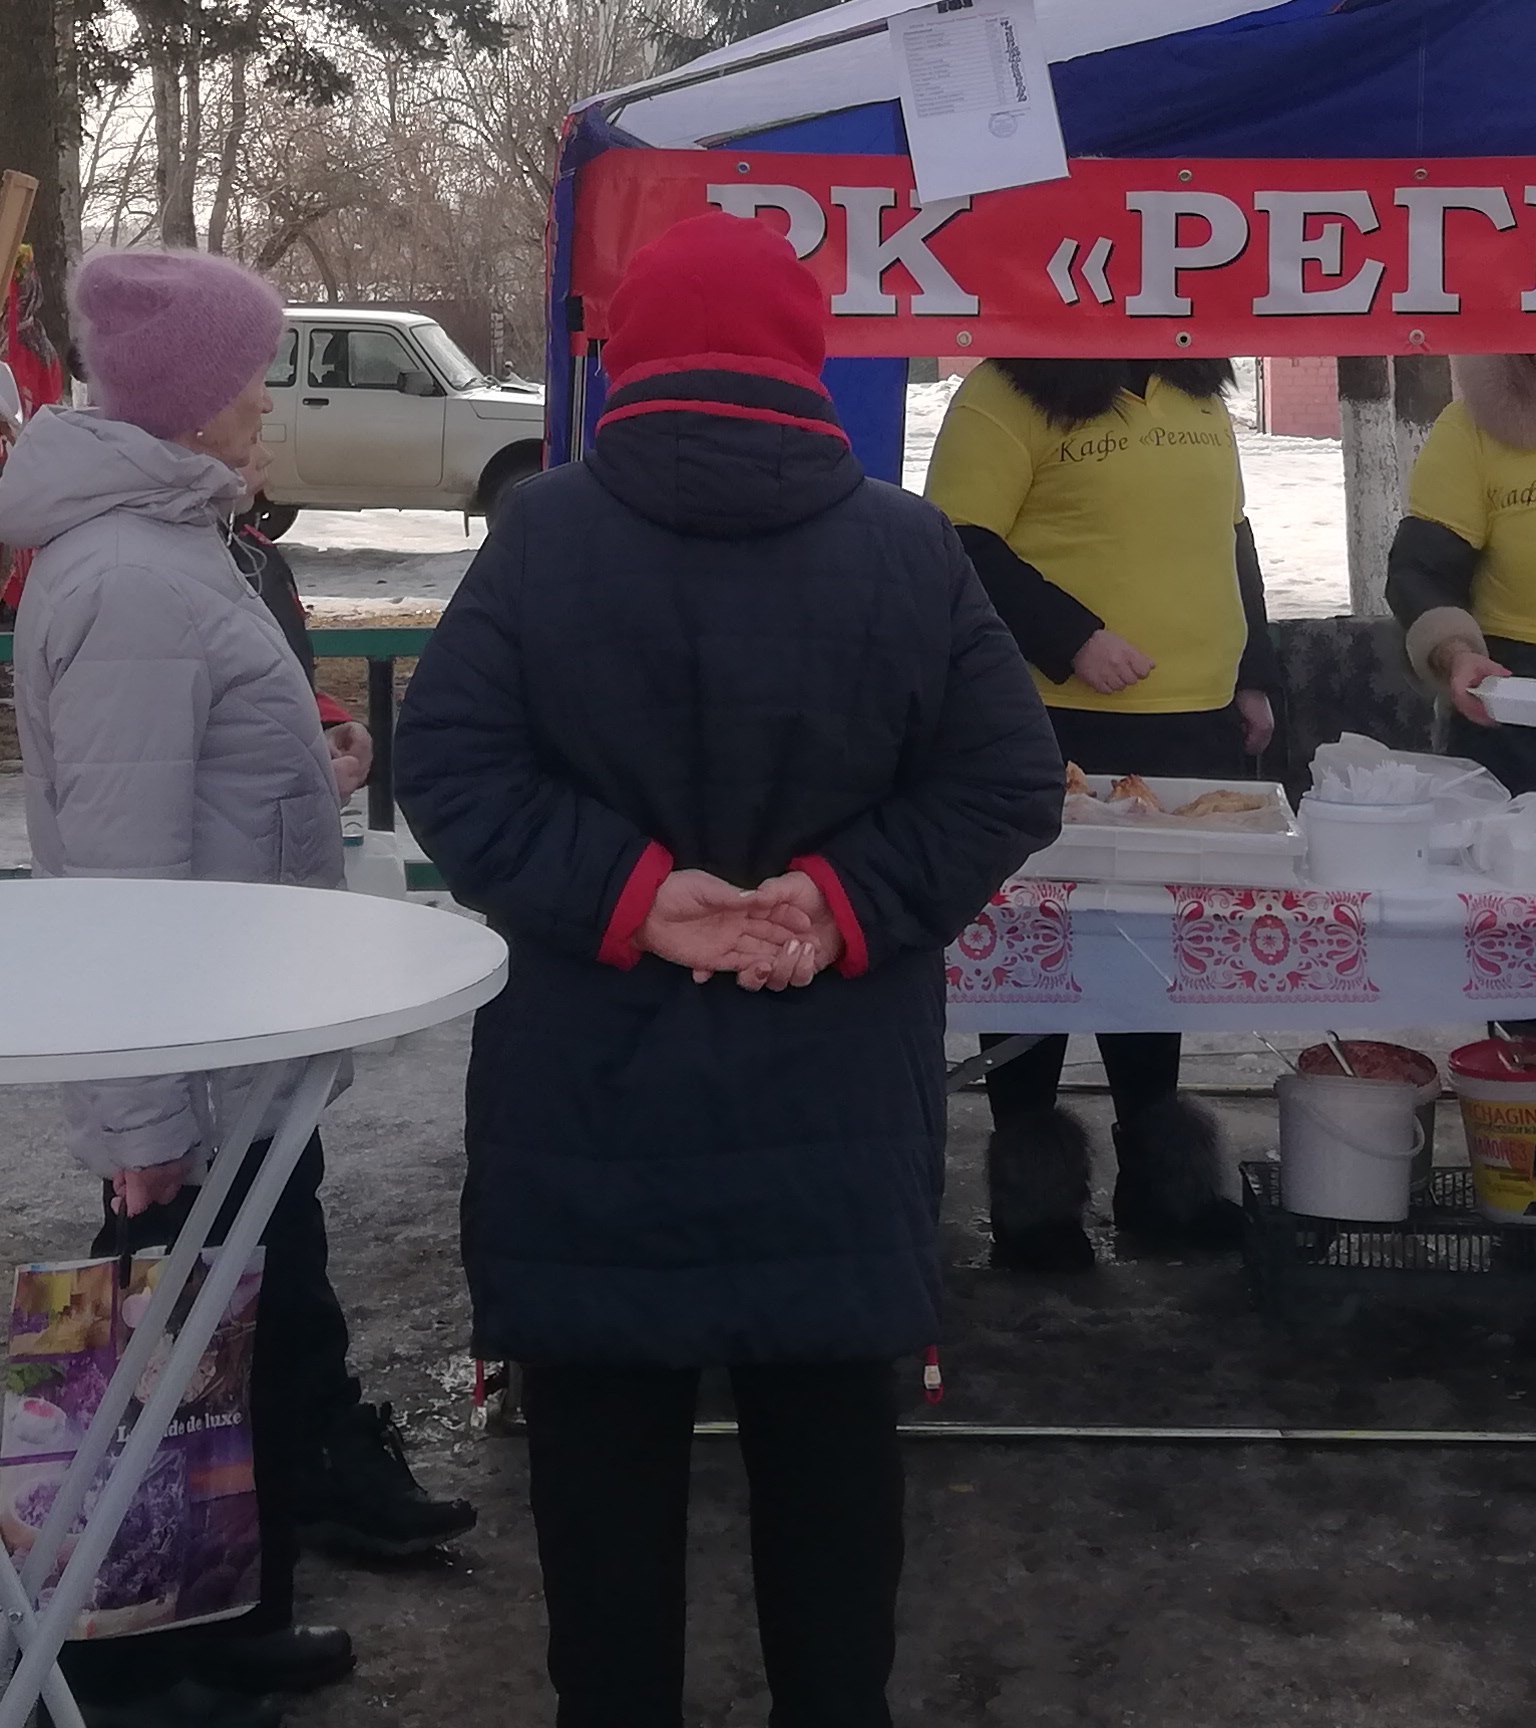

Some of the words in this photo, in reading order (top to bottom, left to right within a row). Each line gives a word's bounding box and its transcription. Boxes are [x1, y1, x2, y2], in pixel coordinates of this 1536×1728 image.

[1059, 430, 1128, 462] Кафе
[1138, 426, 1223, 448] «Регион
[205, 1412, 242, 1428] luxe
